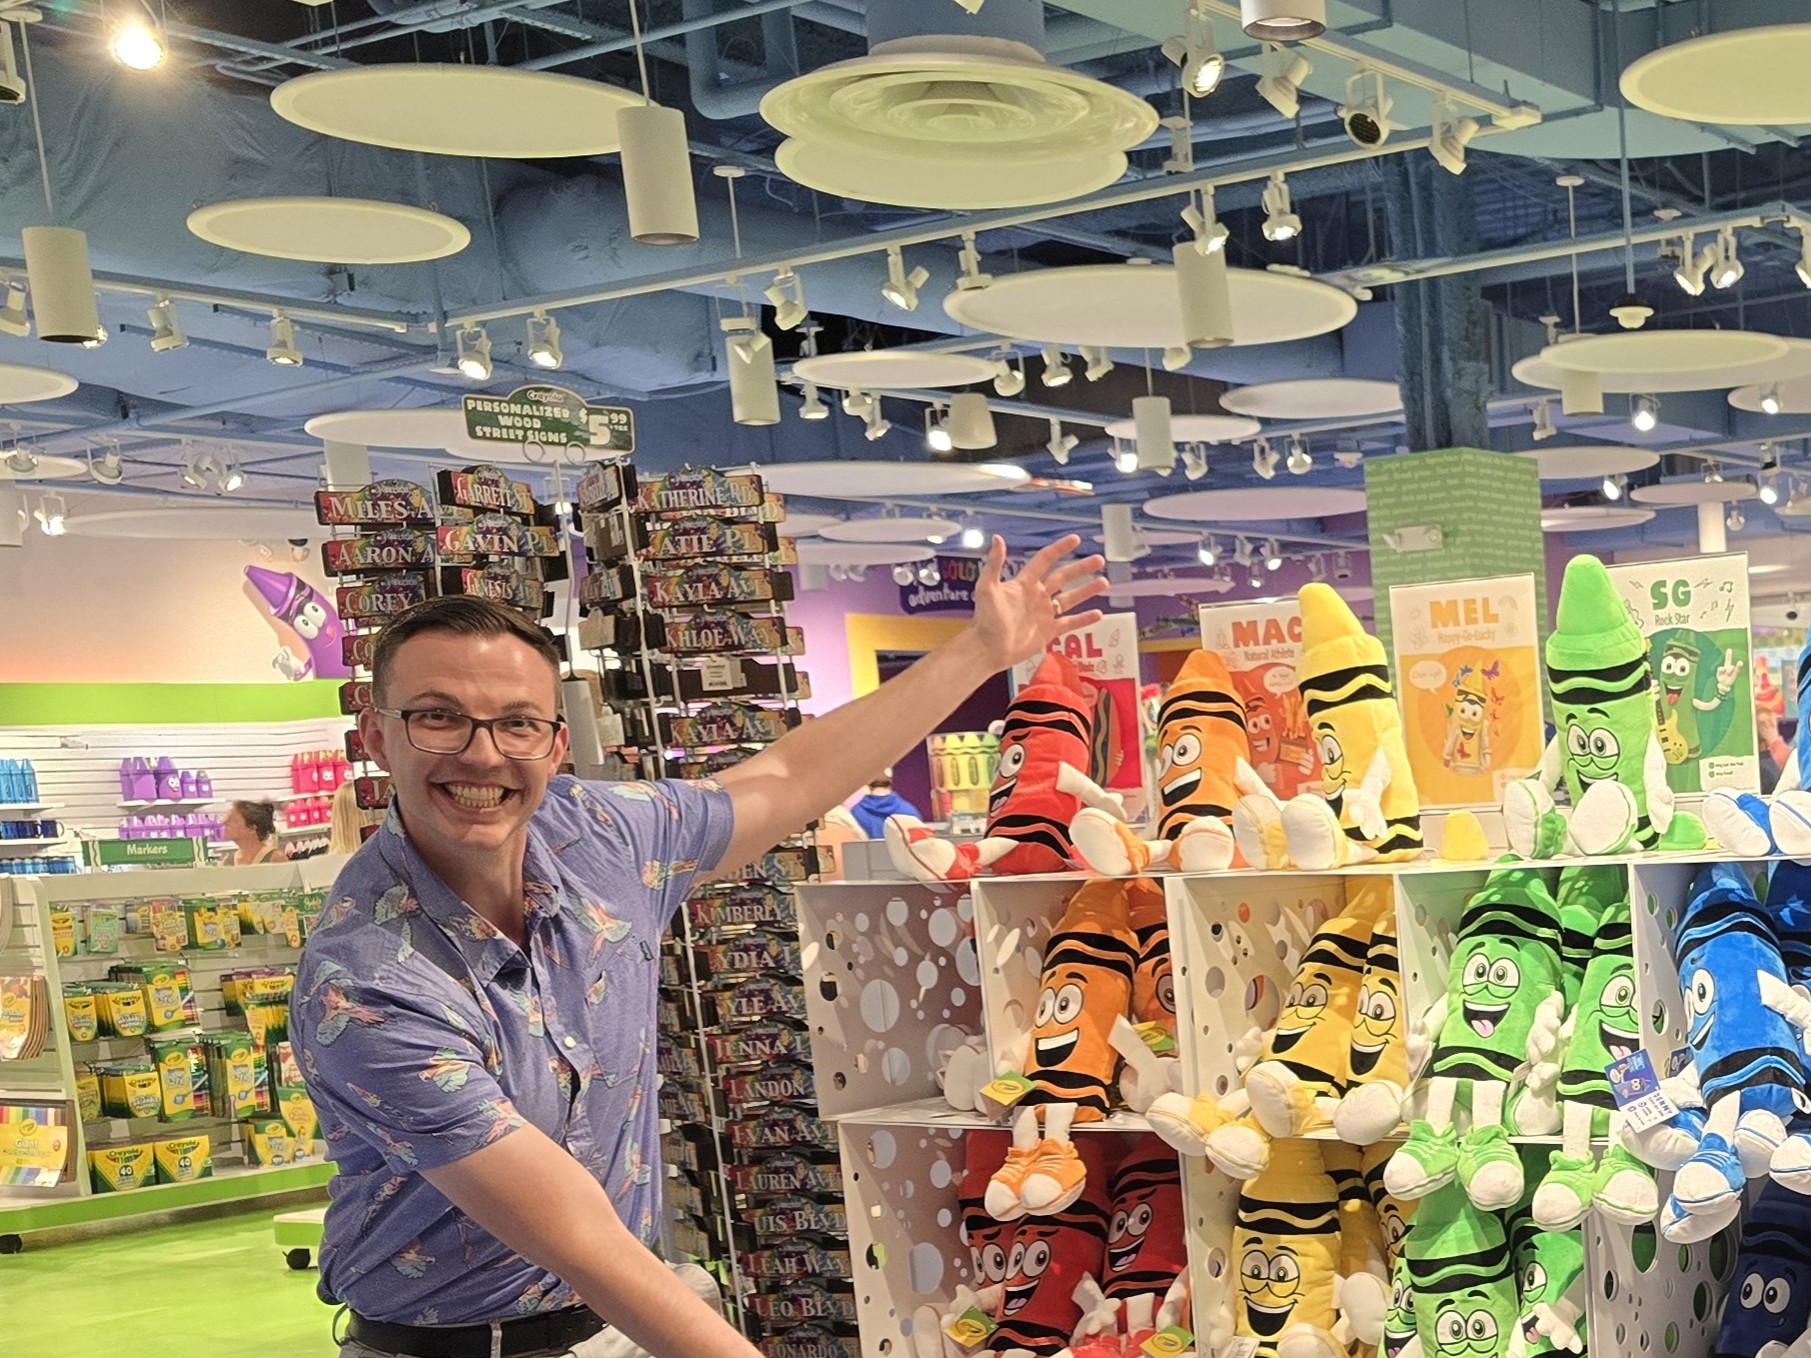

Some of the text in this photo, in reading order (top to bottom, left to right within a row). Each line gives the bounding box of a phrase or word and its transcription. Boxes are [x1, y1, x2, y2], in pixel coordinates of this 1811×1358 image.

[466, 399, 570, 418] PERSONALIZED
[497, 414, 541, 429] WOOD
[475, 425, 567, 443] STREET SIGNS
[329, 497, 408, 519] MILES
[636, 485, 725, 510] KATHERINE
[445, 531, 519, 553] GAVIN
[336, 543, 413, 567] AARON
[655, 580, 721, 603] KAYLA
[1650, 578, 1692, 611] SG
[344, 591, 413, 615] COREY
[1428, 596, 1500, 630] MEL
[1654, 612, 1691, 627] Rock Star
[1231, 615, 1302, 649] MAC
[1437, 627, 1496, 646] Happy-Go-Lucky
[1243, 649, 1269, 661] Natural
[126, 843, 168, 856] Markers
[695, 903, 782, 925] KIMBERLY
[717, 950, 775, 970] YDIA
[728, 988, 802, 1015] YLE AV
[729, 1077, 806, 1100] LANDON
[15, 1137, 39, 1149] Giant
[120, 1166, 133, 1175] 40
[179, 1157, 191, 1167] 40
[735, 1171, 801, 1190] LAUREN
[753, 1214, 788, 1233] UIS
[748, 1253, 798, 1274] LEAH
[754, 1296, 855, 1318] LEO BLVD
